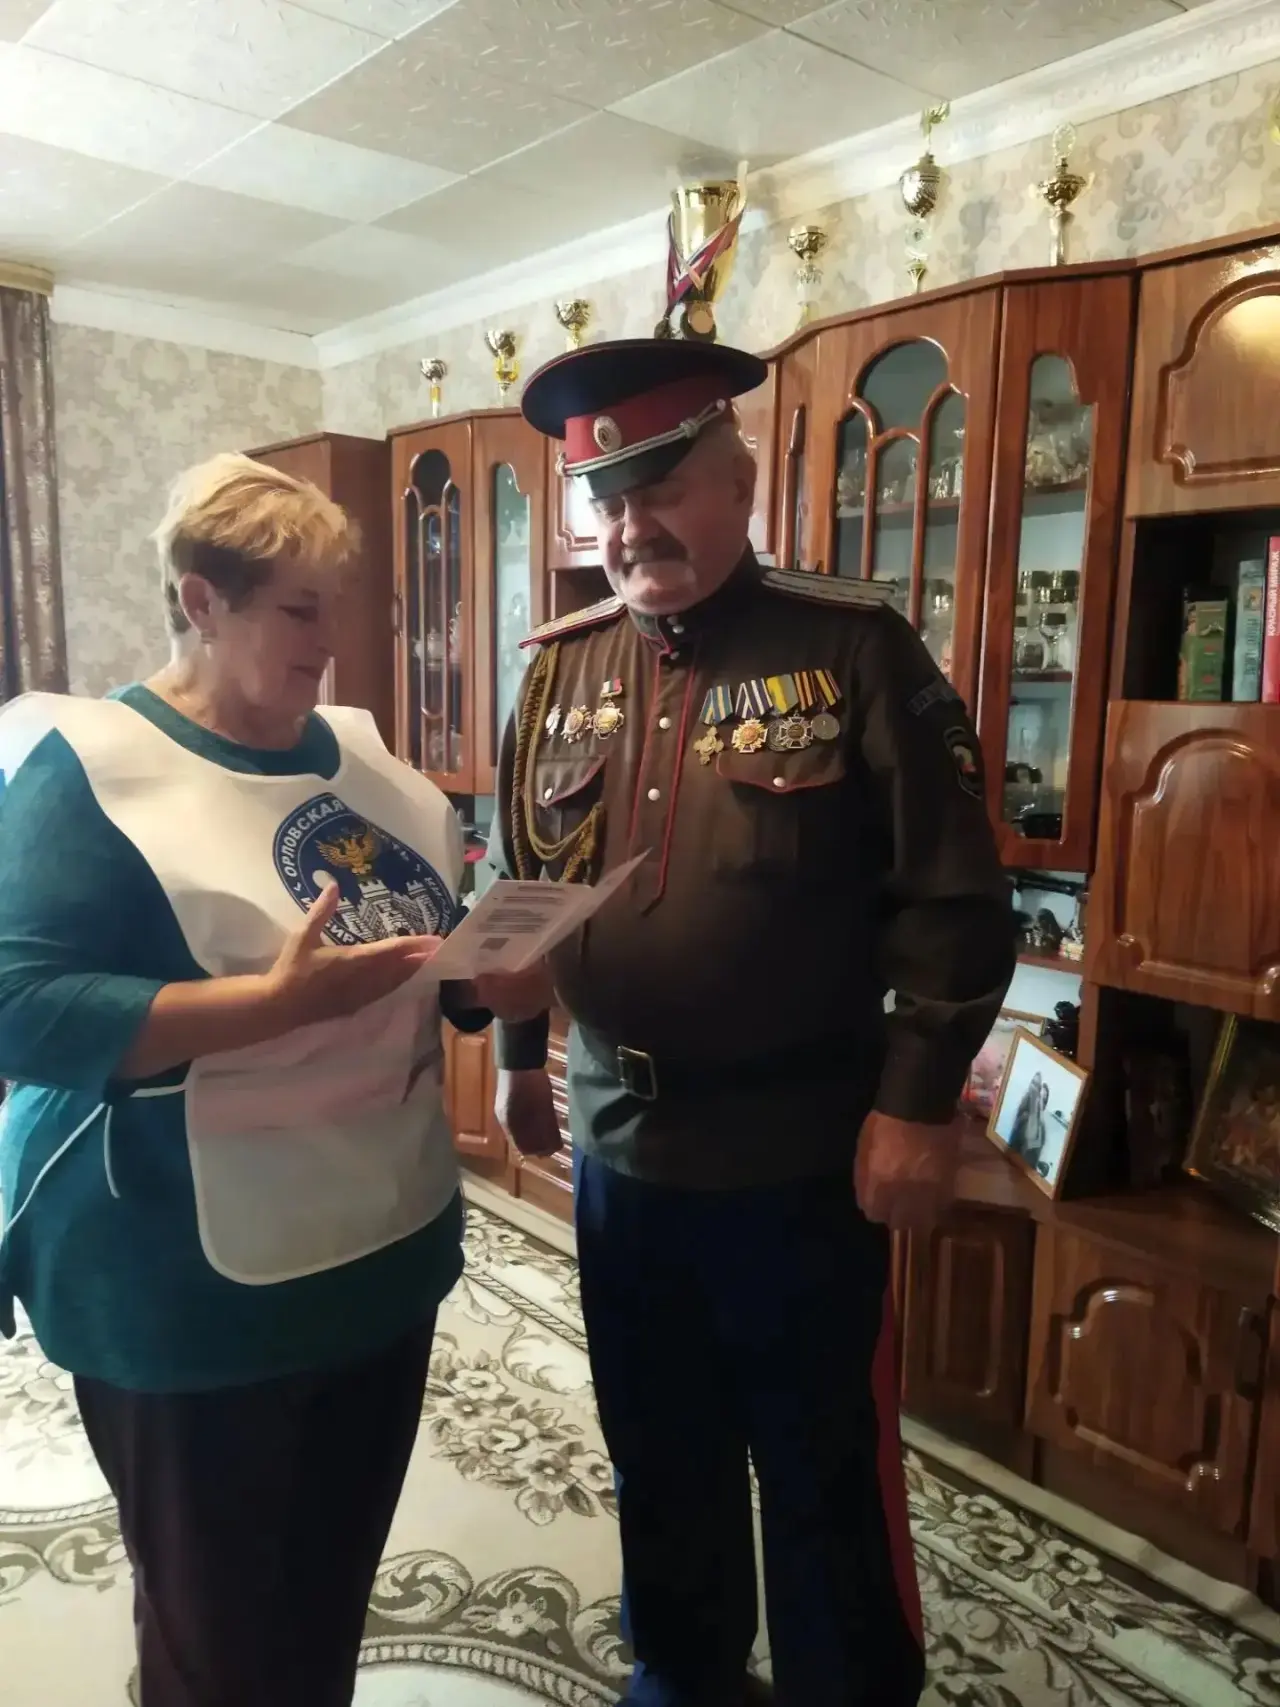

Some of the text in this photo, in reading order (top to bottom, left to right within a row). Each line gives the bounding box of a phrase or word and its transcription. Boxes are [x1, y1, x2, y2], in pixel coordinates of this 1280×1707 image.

[1267, 551, 1280, 637] КРАСНЫЙ МИРАЖ
[281, 799, 345, 878] ОРЛОВСКАЯ
